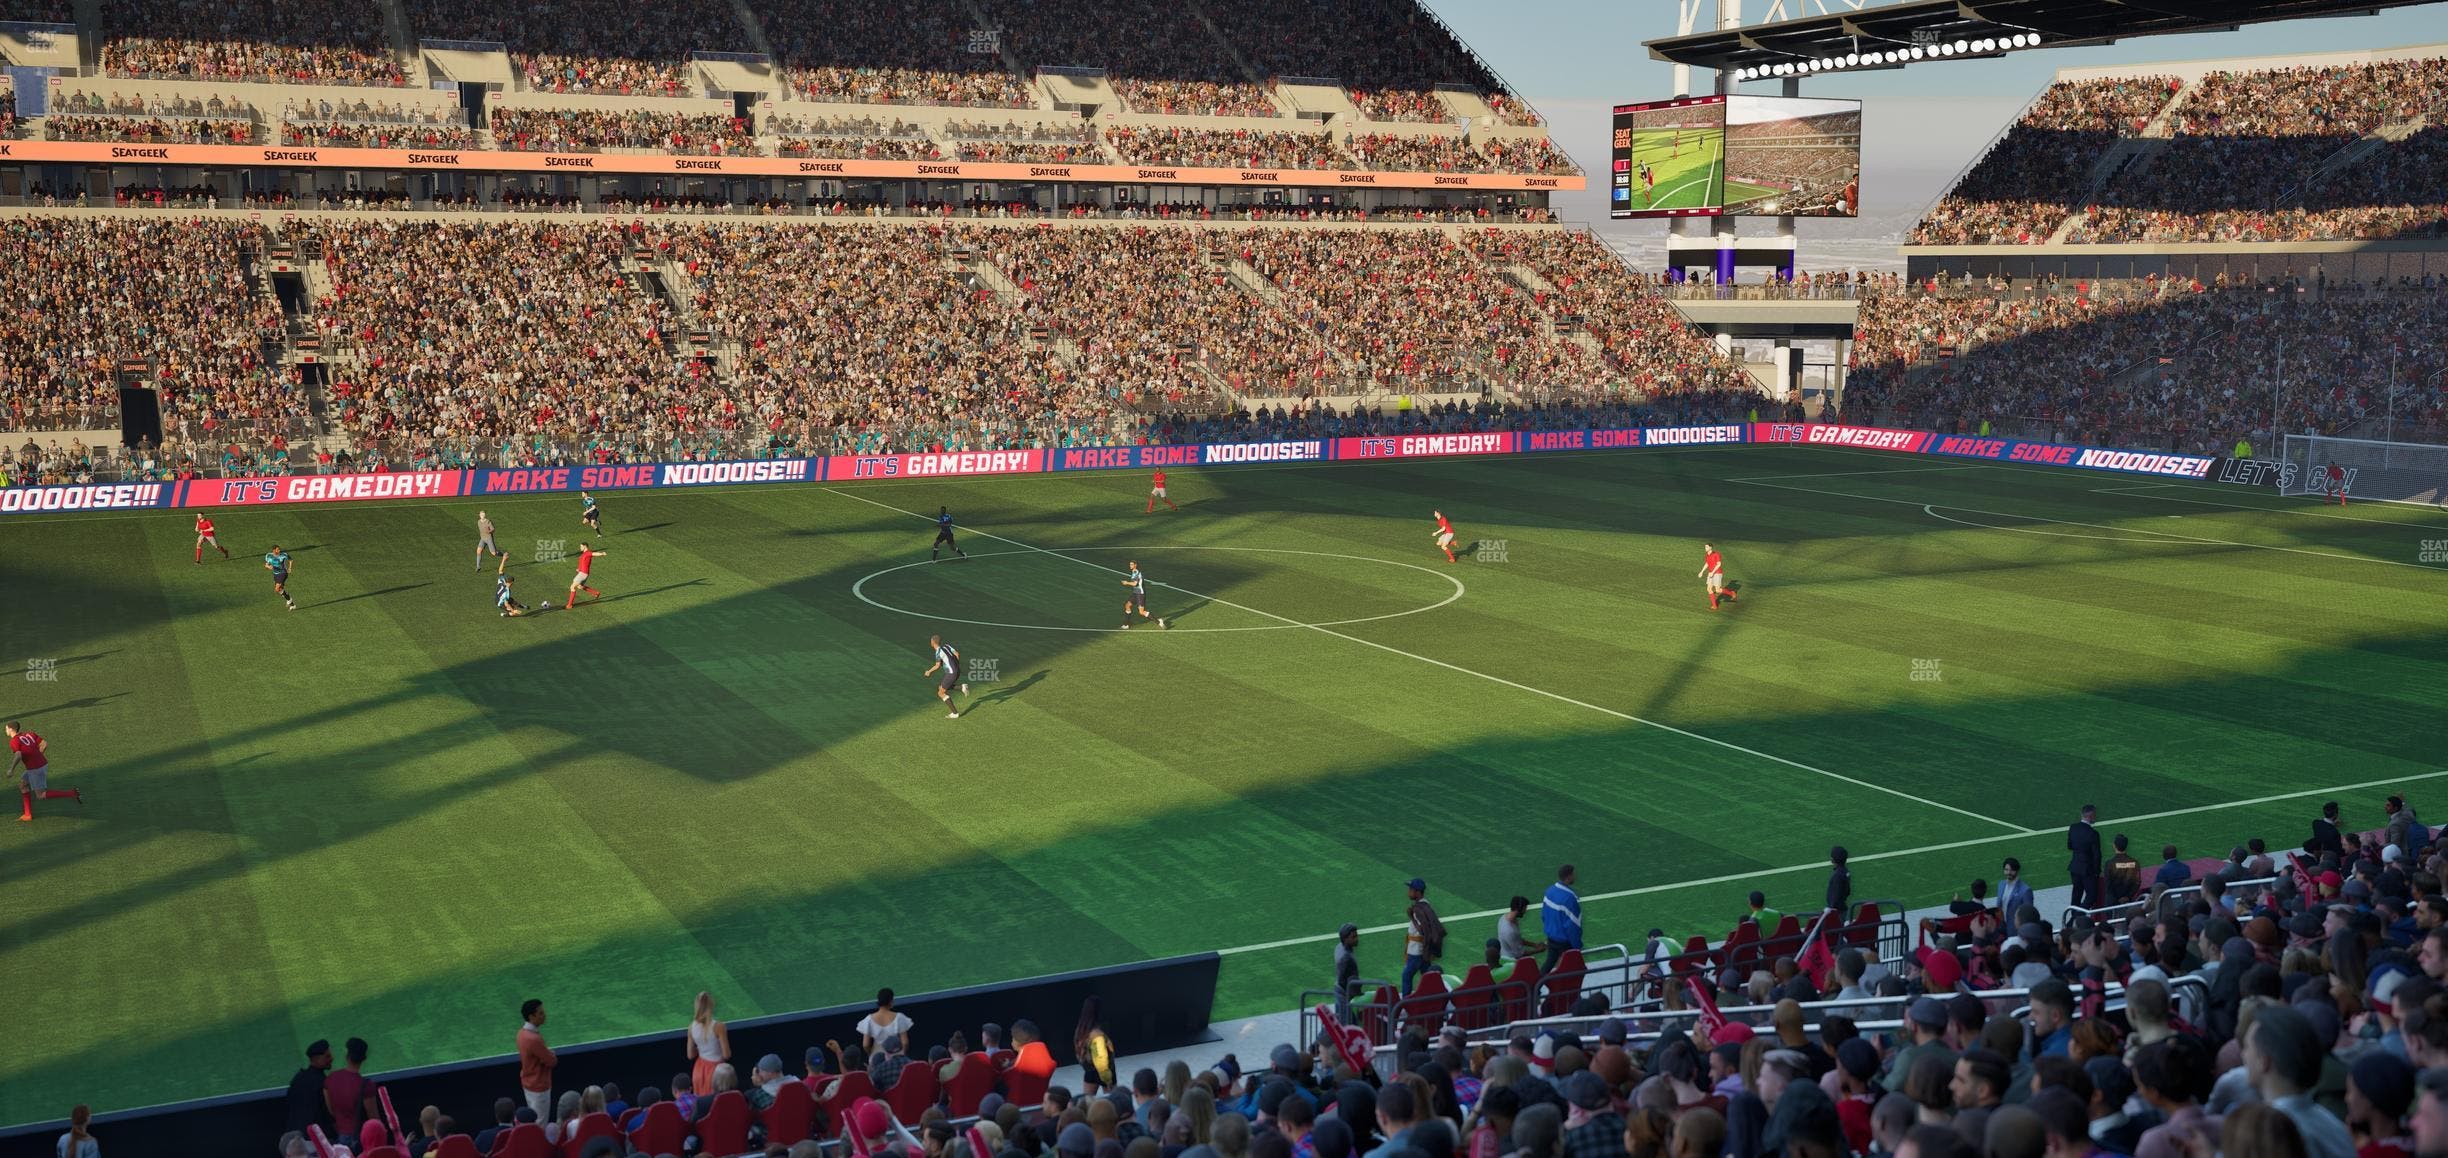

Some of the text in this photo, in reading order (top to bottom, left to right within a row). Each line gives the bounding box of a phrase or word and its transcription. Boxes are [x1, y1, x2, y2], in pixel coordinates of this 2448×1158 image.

[1615, 128, 1631, 138] SEAT
[1614, 138, 1631, 148] GEEK
[112, 147, 168, 159] SEATGEEK
[264, 151, 317, 162] SEATGEEK
[408, 154, 459, 165] SEATGEEK
[545, 157, 594, 168] SEATGEEK
[676, 160, 721, 171] SEATGEEK
[800, 162, 843, 173] SEATGEEK
[918, 165, 959, 175] SEATGEEK
[1031, 167, 1070, 177] SEATGEEK
[1139, 170, 1177, 179] SEATGEEK
[1242, 172, 1278, 181] SEATGEEK
[1340, 175, 1375, 183] SEATGEEK
[1435, 177, 1468, 185] SEATGEEK
[1525, 178, 1558, 187] SEATGEEK
[1530, 426, 1740, 450] MAKE SOME NOOOOISE!!!
[1770, 424, 1914, 449] IT'S GAMEDAY!
[1360, 434, 1501, 456] IT'S GAMEDAY!
[1938, 436, 2007, 457] MAKE
[2008, 441, 2078, 464] SOME
[1064, 441, 1321, 468] MAKE SOME NOOOOISE!!!
[854, 451, 1029, 477] IT'S GAMEDAY!
[486, 460, 808, 492] MAKE SOME NOOOOISE!!!
[2218, 458, 2299, 489] LET'S
[220, 473, 442, 503] IT'S GAMEDAY!
[0, 483, 161, 512] OOOOISE!!!
